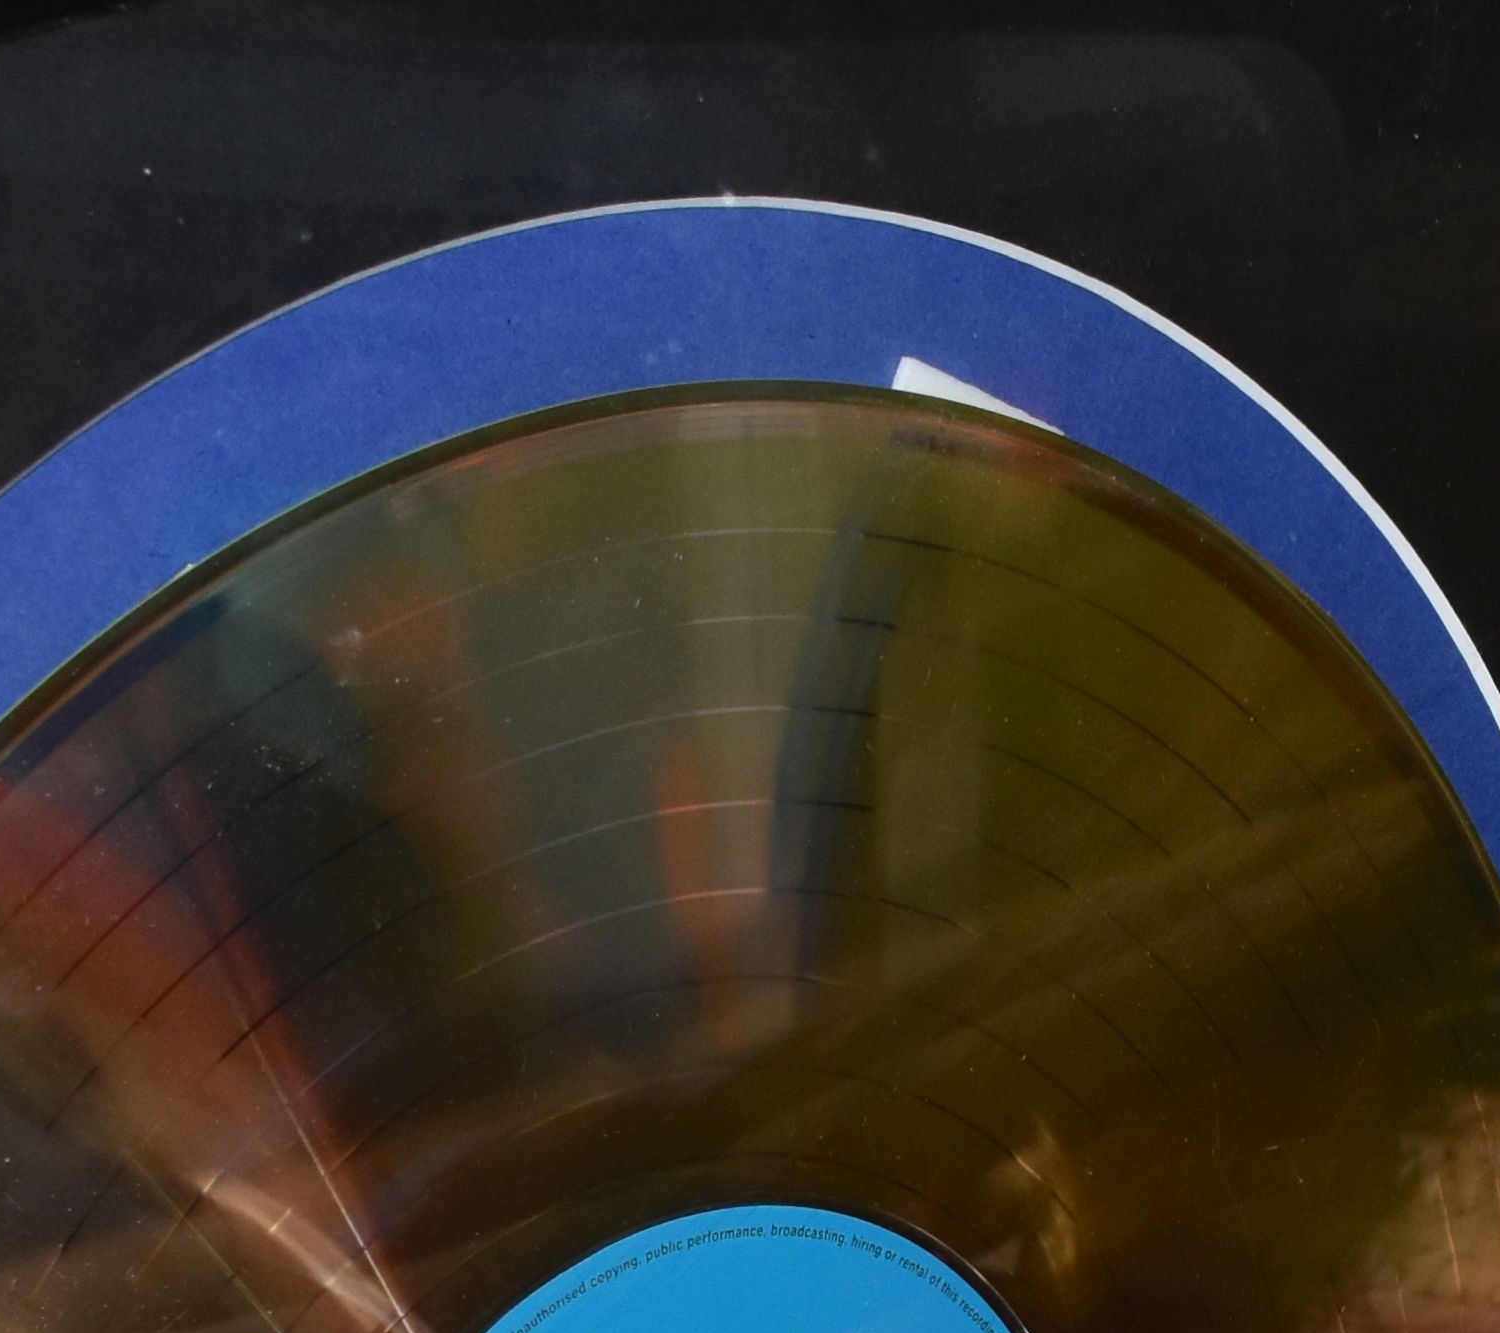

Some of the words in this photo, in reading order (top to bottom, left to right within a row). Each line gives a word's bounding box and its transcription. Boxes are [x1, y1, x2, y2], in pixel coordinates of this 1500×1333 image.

[644, 1238, 684, 1265] public
[850, 1234, 882, 1259] hiring
[884, 1246, 896, 1262] or
[898, 1255, 929, 1279] rental
[928, 1273, 942, 1288] of
[939, 1280, 959, 1303] this
